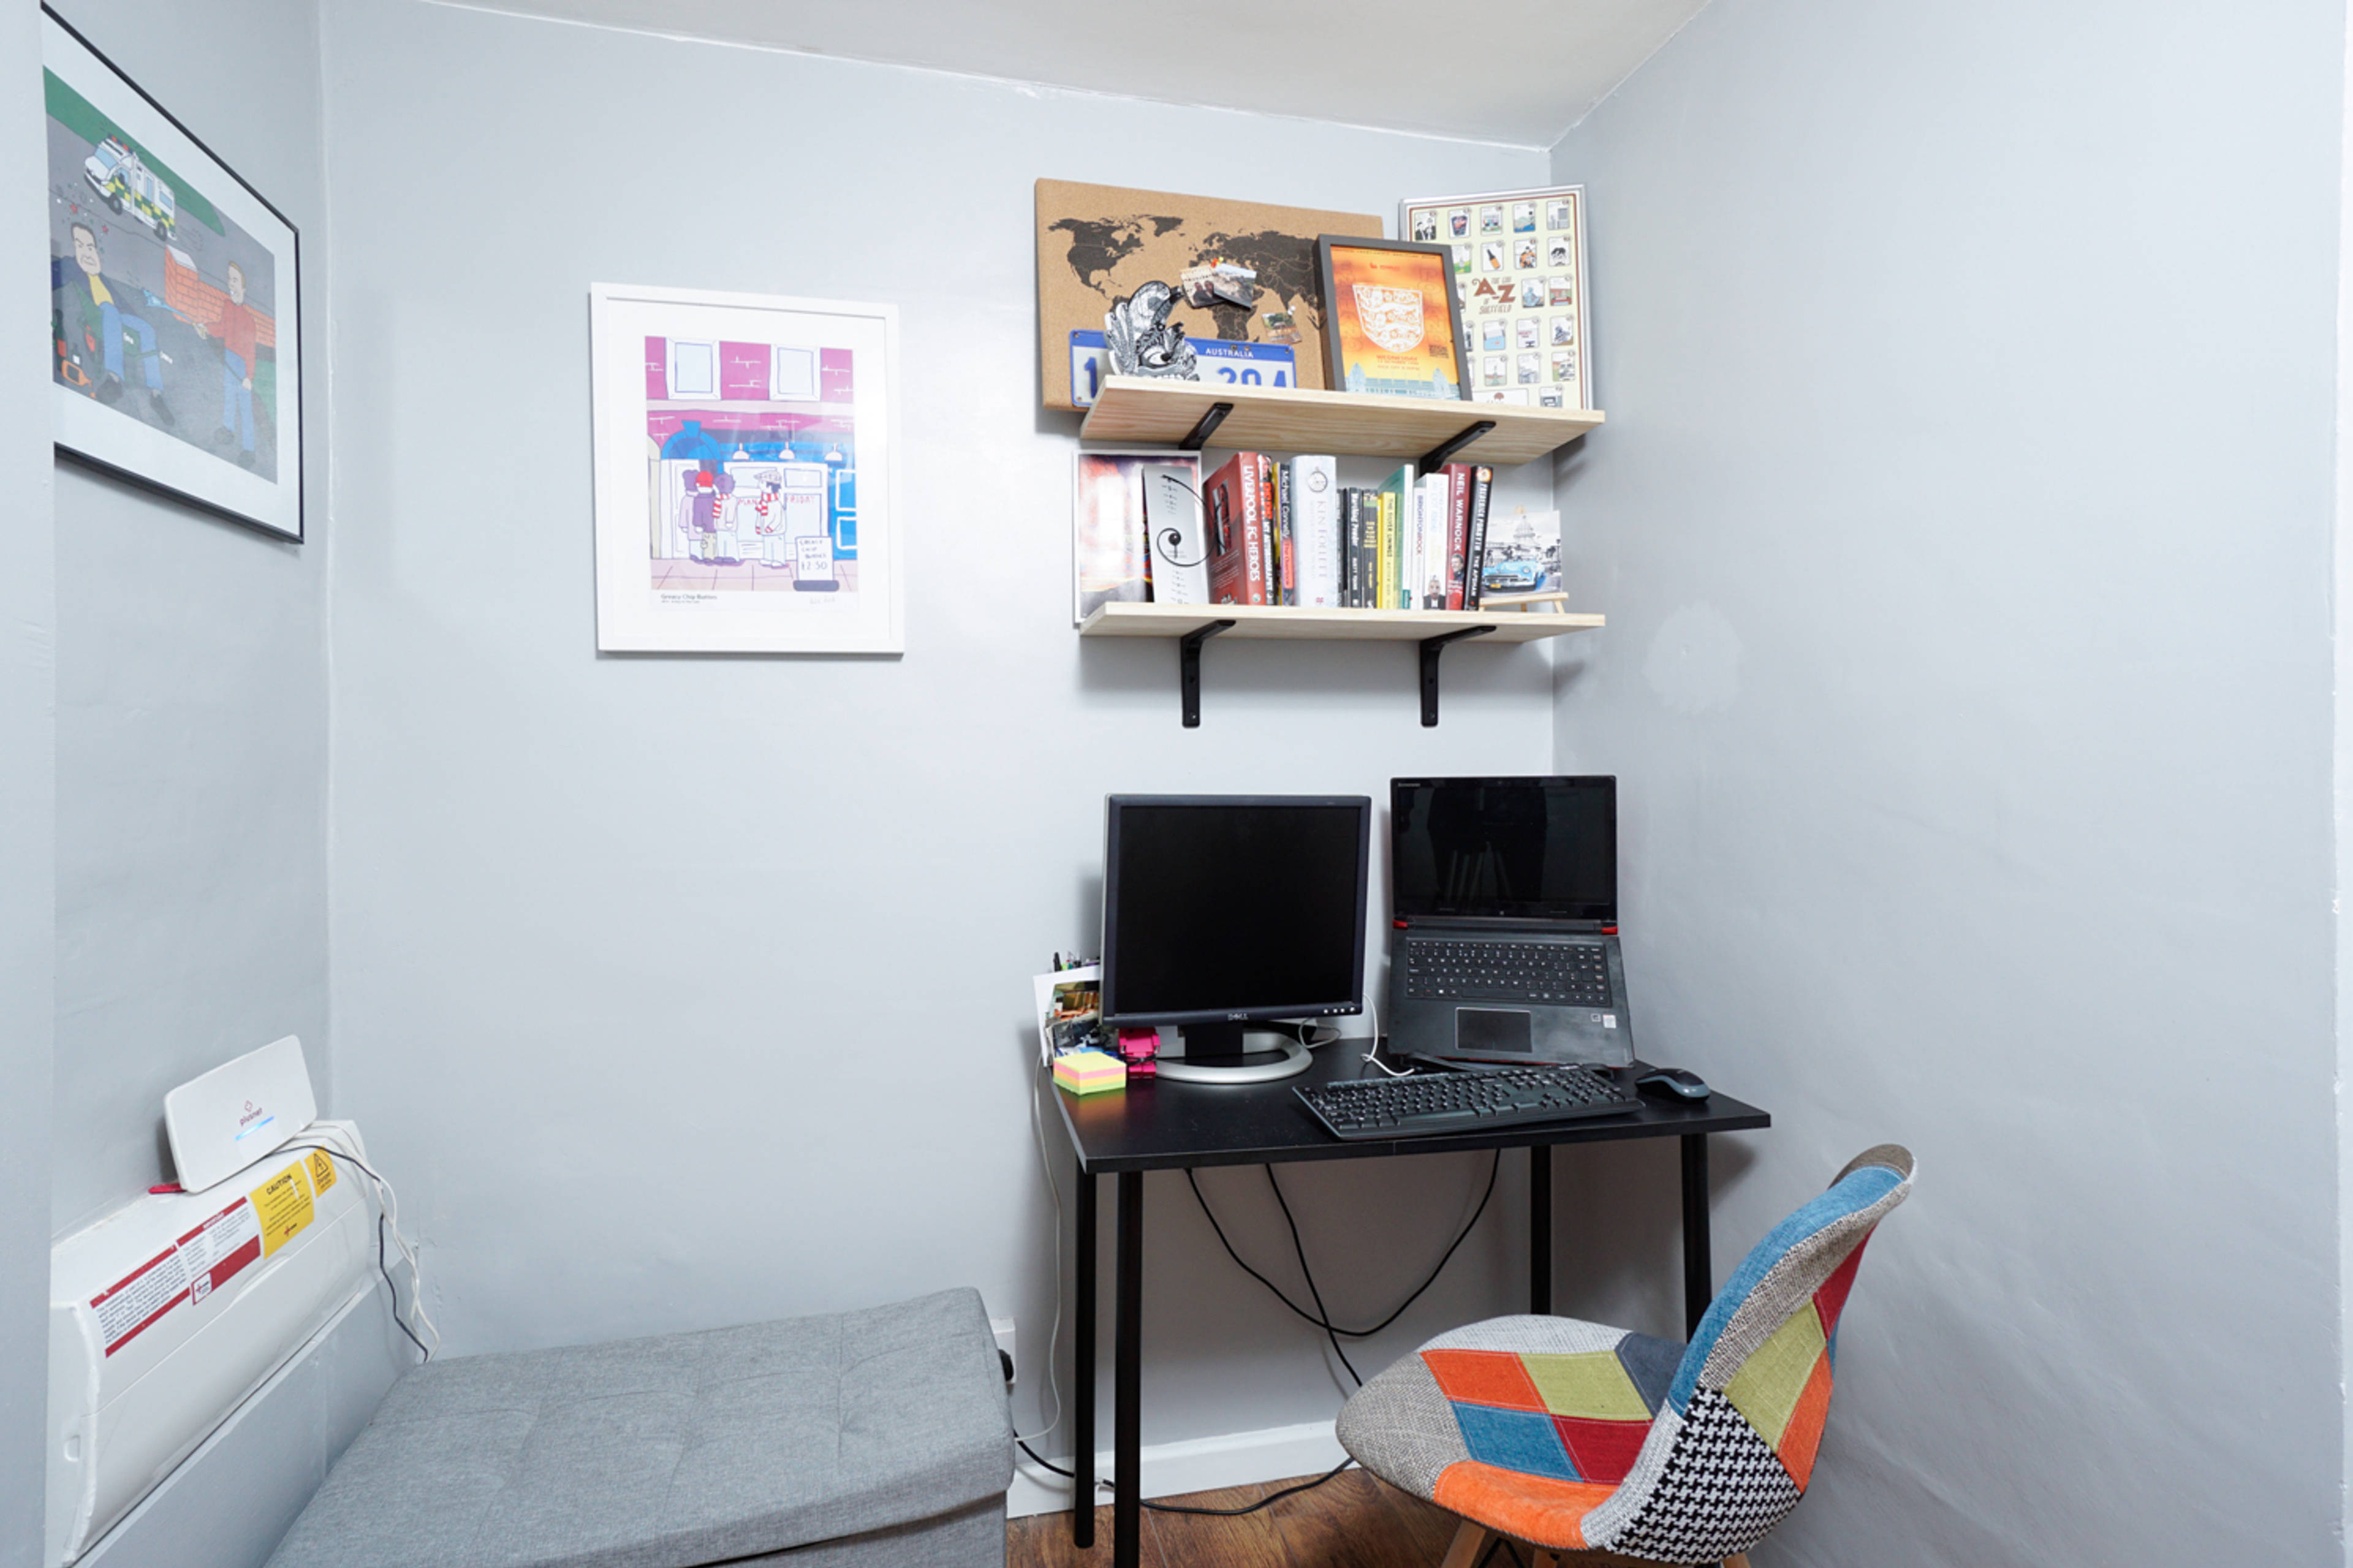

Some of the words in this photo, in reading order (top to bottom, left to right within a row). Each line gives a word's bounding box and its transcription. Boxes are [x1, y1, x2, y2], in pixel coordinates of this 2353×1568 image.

[1205, 347, 1254, 359] AUSTRALIA
[1243, 465, 1256, 523] LIVERPOOL
[1281, 470, 1290, 504] Michael
[1456, 472, 1465, 496] NEIL
[1477, 483, 1487, 517] FREDERICK
[1282, 506, 1290, 538] Connelly
[1317, 501, 1327, 525] KEN
[1351, 493, 1359, 522] Marching
[1247, 526, 1257, 539] FC
[1454, 499, 1464, 551] WARNOCK
[1474, 518, 1484, 550] FORSYTH
[1248, 542, 1260, 582] HEROES
[1264, 534, 1273, 591] AUTOBIOGRAPHY
[1317, 529, 1328, 579] FOLLETT
[240, 1107, 263, 1126] plusnet
[266, 1174, 293, 1195] CAUTION
